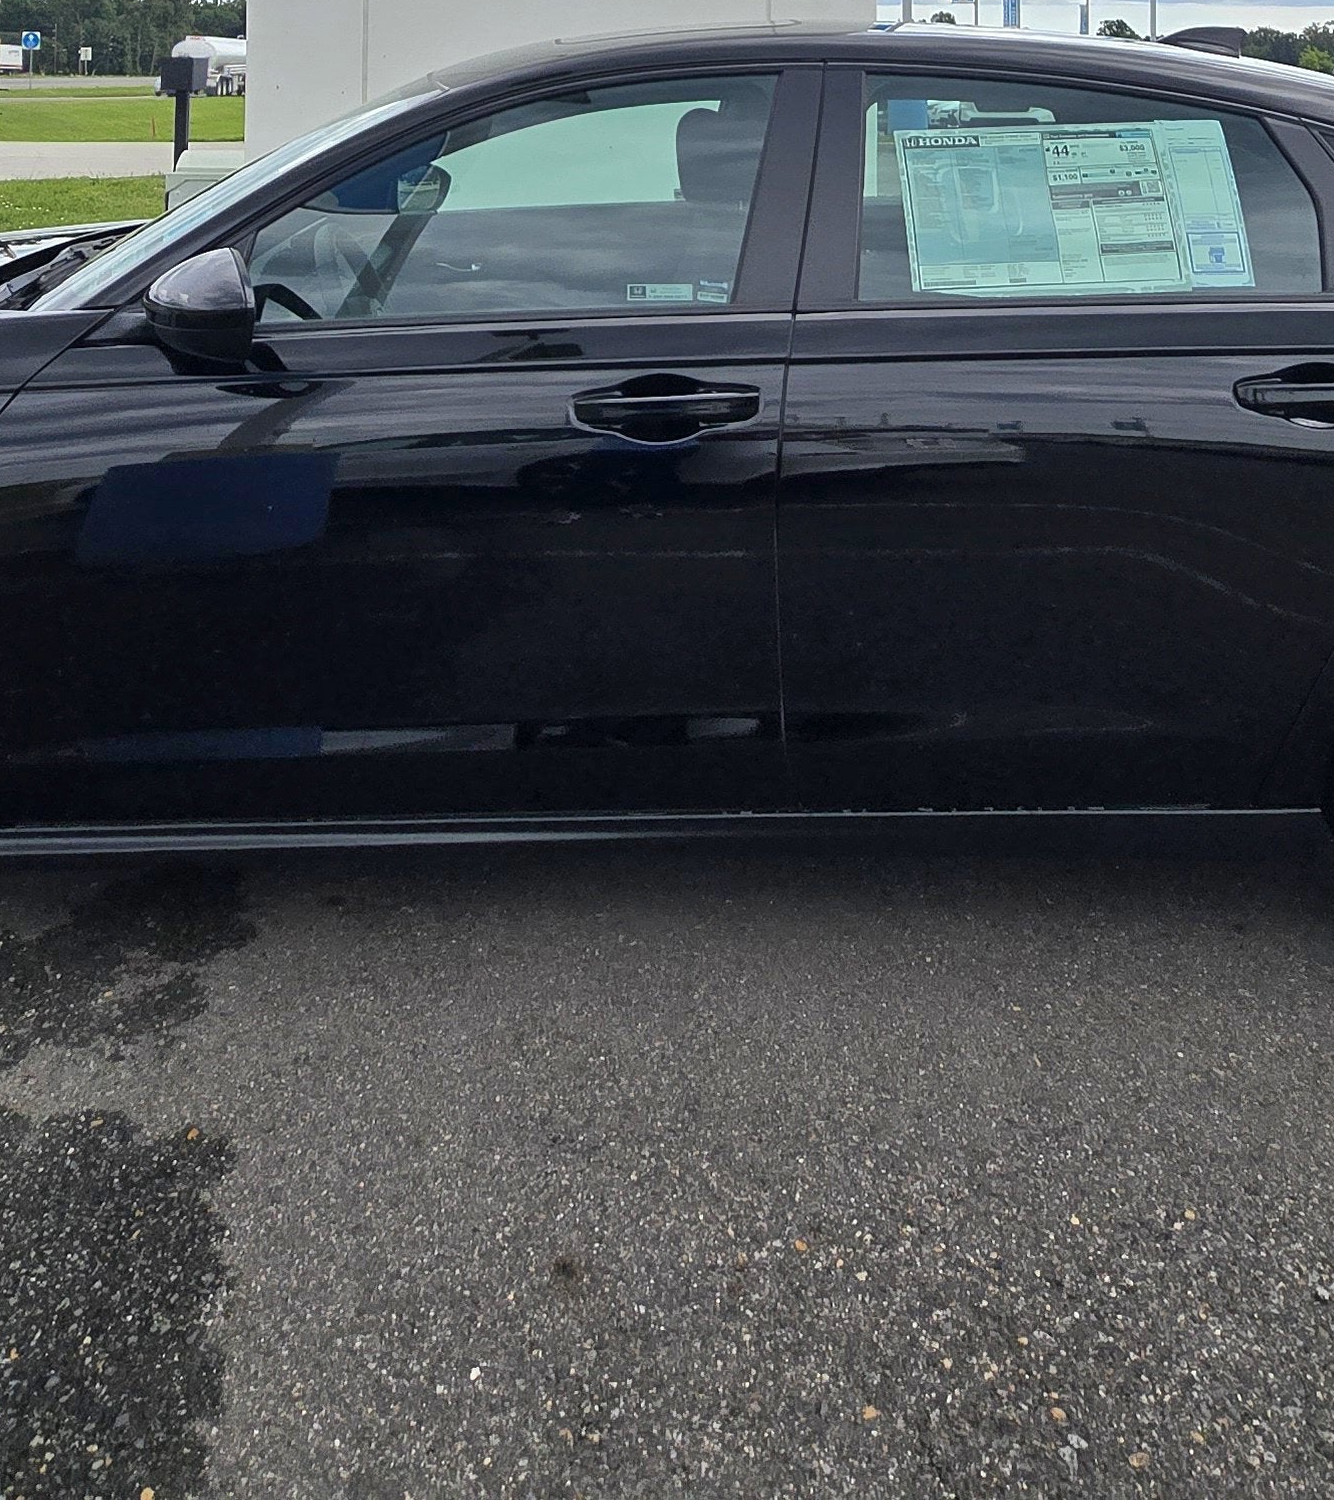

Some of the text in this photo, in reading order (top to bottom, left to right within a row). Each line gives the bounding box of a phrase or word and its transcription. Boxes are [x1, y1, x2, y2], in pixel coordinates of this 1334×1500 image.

[918, 136, 978, 146] HONDA
[1051, 144, 1070, 157] 44
[1052, 172, 1078, 181] $1,100
